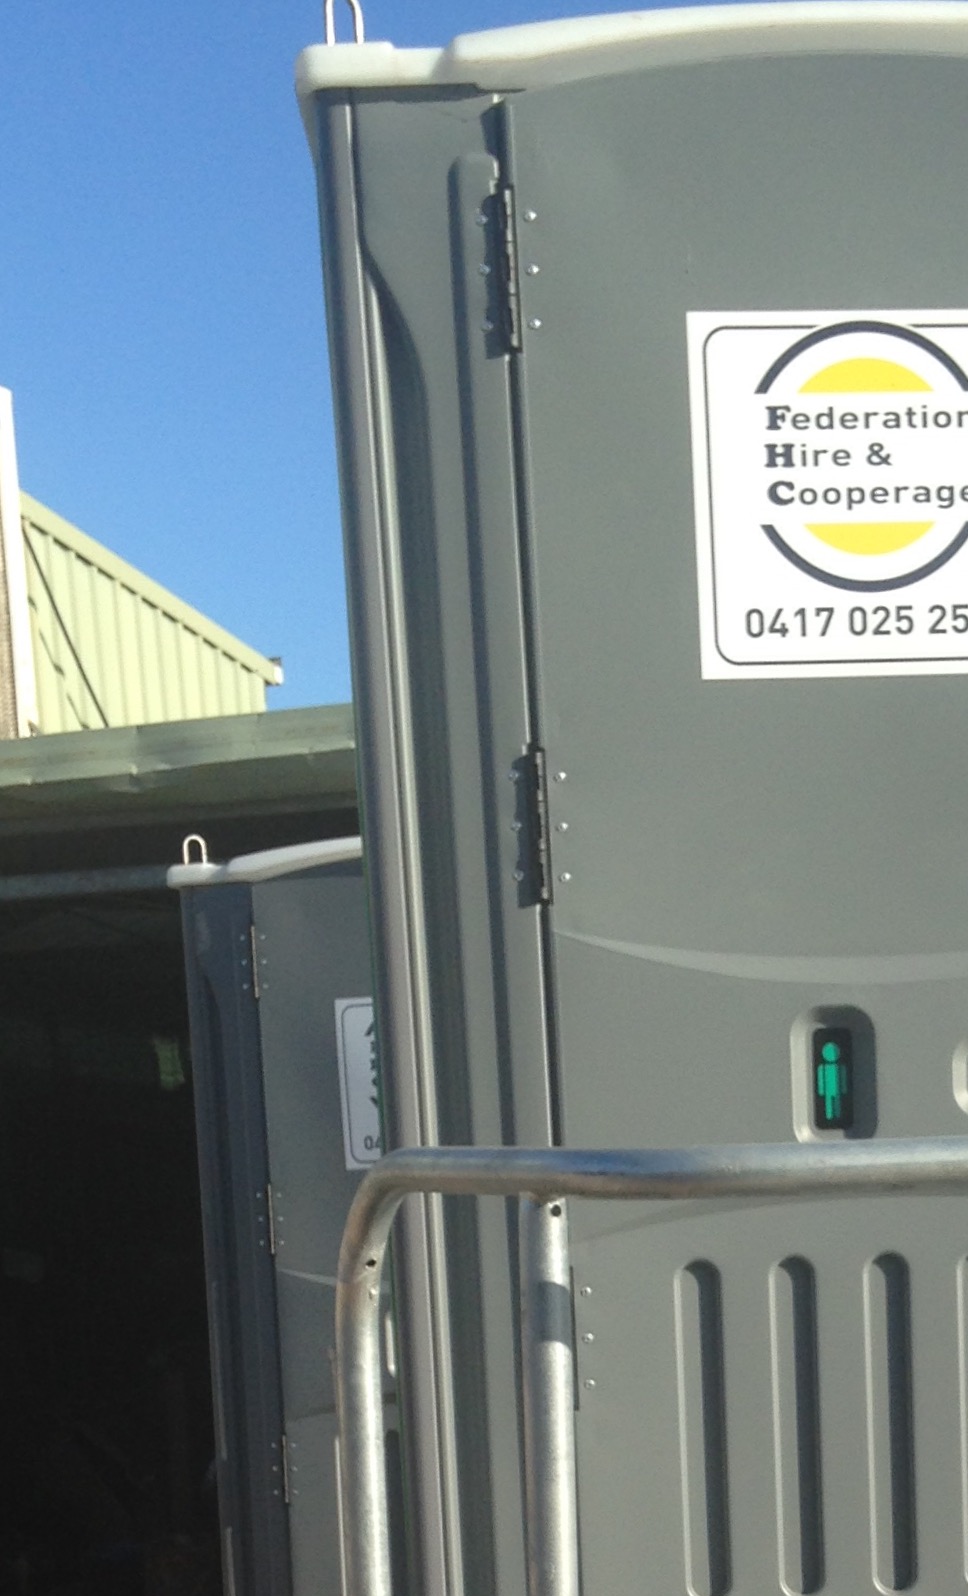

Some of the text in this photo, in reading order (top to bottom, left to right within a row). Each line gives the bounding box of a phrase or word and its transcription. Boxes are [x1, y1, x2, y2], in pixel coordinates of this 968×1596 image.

[764, 442, 893, 468] Hire &
[745, 606, 835, 639] 0417
[848, 604, 914, 637] 025
